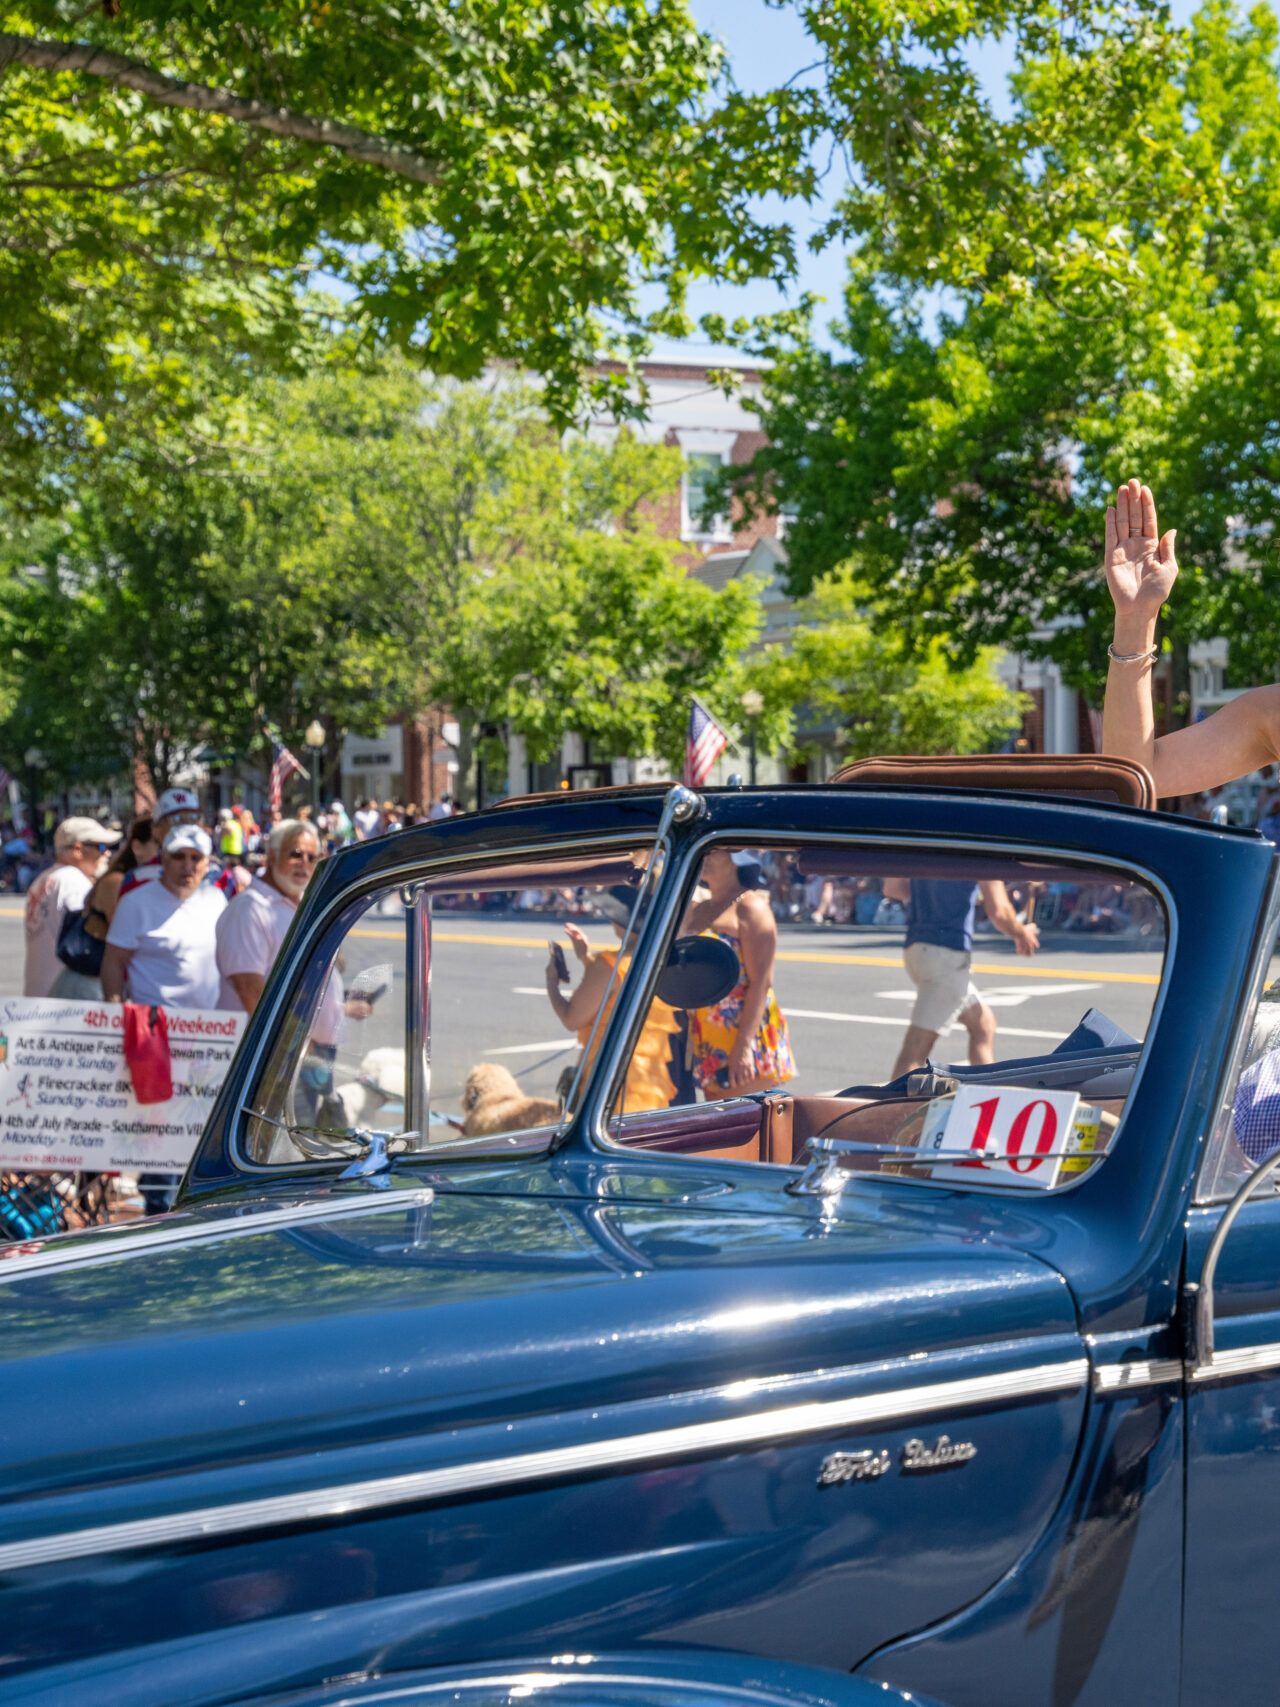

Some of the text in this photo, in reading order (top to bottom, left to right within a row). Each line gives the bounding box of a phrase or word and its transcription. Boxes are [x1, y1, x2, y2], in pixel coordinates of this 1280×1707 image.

[83, 1009, 108, 1028] 4th
[166, 1015, 237, 1036] Weekend!
[16, 1037, 35, 1050] Art
[36, 1038, 46, 1051] &
[48, 1038, 95, 1055] Antique
[96, 1040, 124, 1055] Fest
[206, 1048, 231, 1061] Park
[13, 1053, 64, 1070] Saturday
[75, 1056, 117, 1073] Sunday
[38, 1076, 112, 1092] Firecracker
[114, 1080, 132, 1093] 8K
[195, 1085, 221, 1097] Wal
[36, 1092, 86, 1108] Sunday
[96, 1095, 128, 1108] 8am
[5, 1115, 24, 1128] 4th
[25, 1114, 40, 1129] of
[39, 1115, 62, 1132] July
[63, 1117, 102, 1131] Parade
[112, 1119, 184, 1137] Southampton
[951, 1096, 1059, 1174] 10
[2, 1132, 57, 1148] Monday
[69, 1134, 105, 1147] 10am
[110, 1158, 189, 1169] SouthamptonCham
[815, 1449, 892, 1485] Ford
